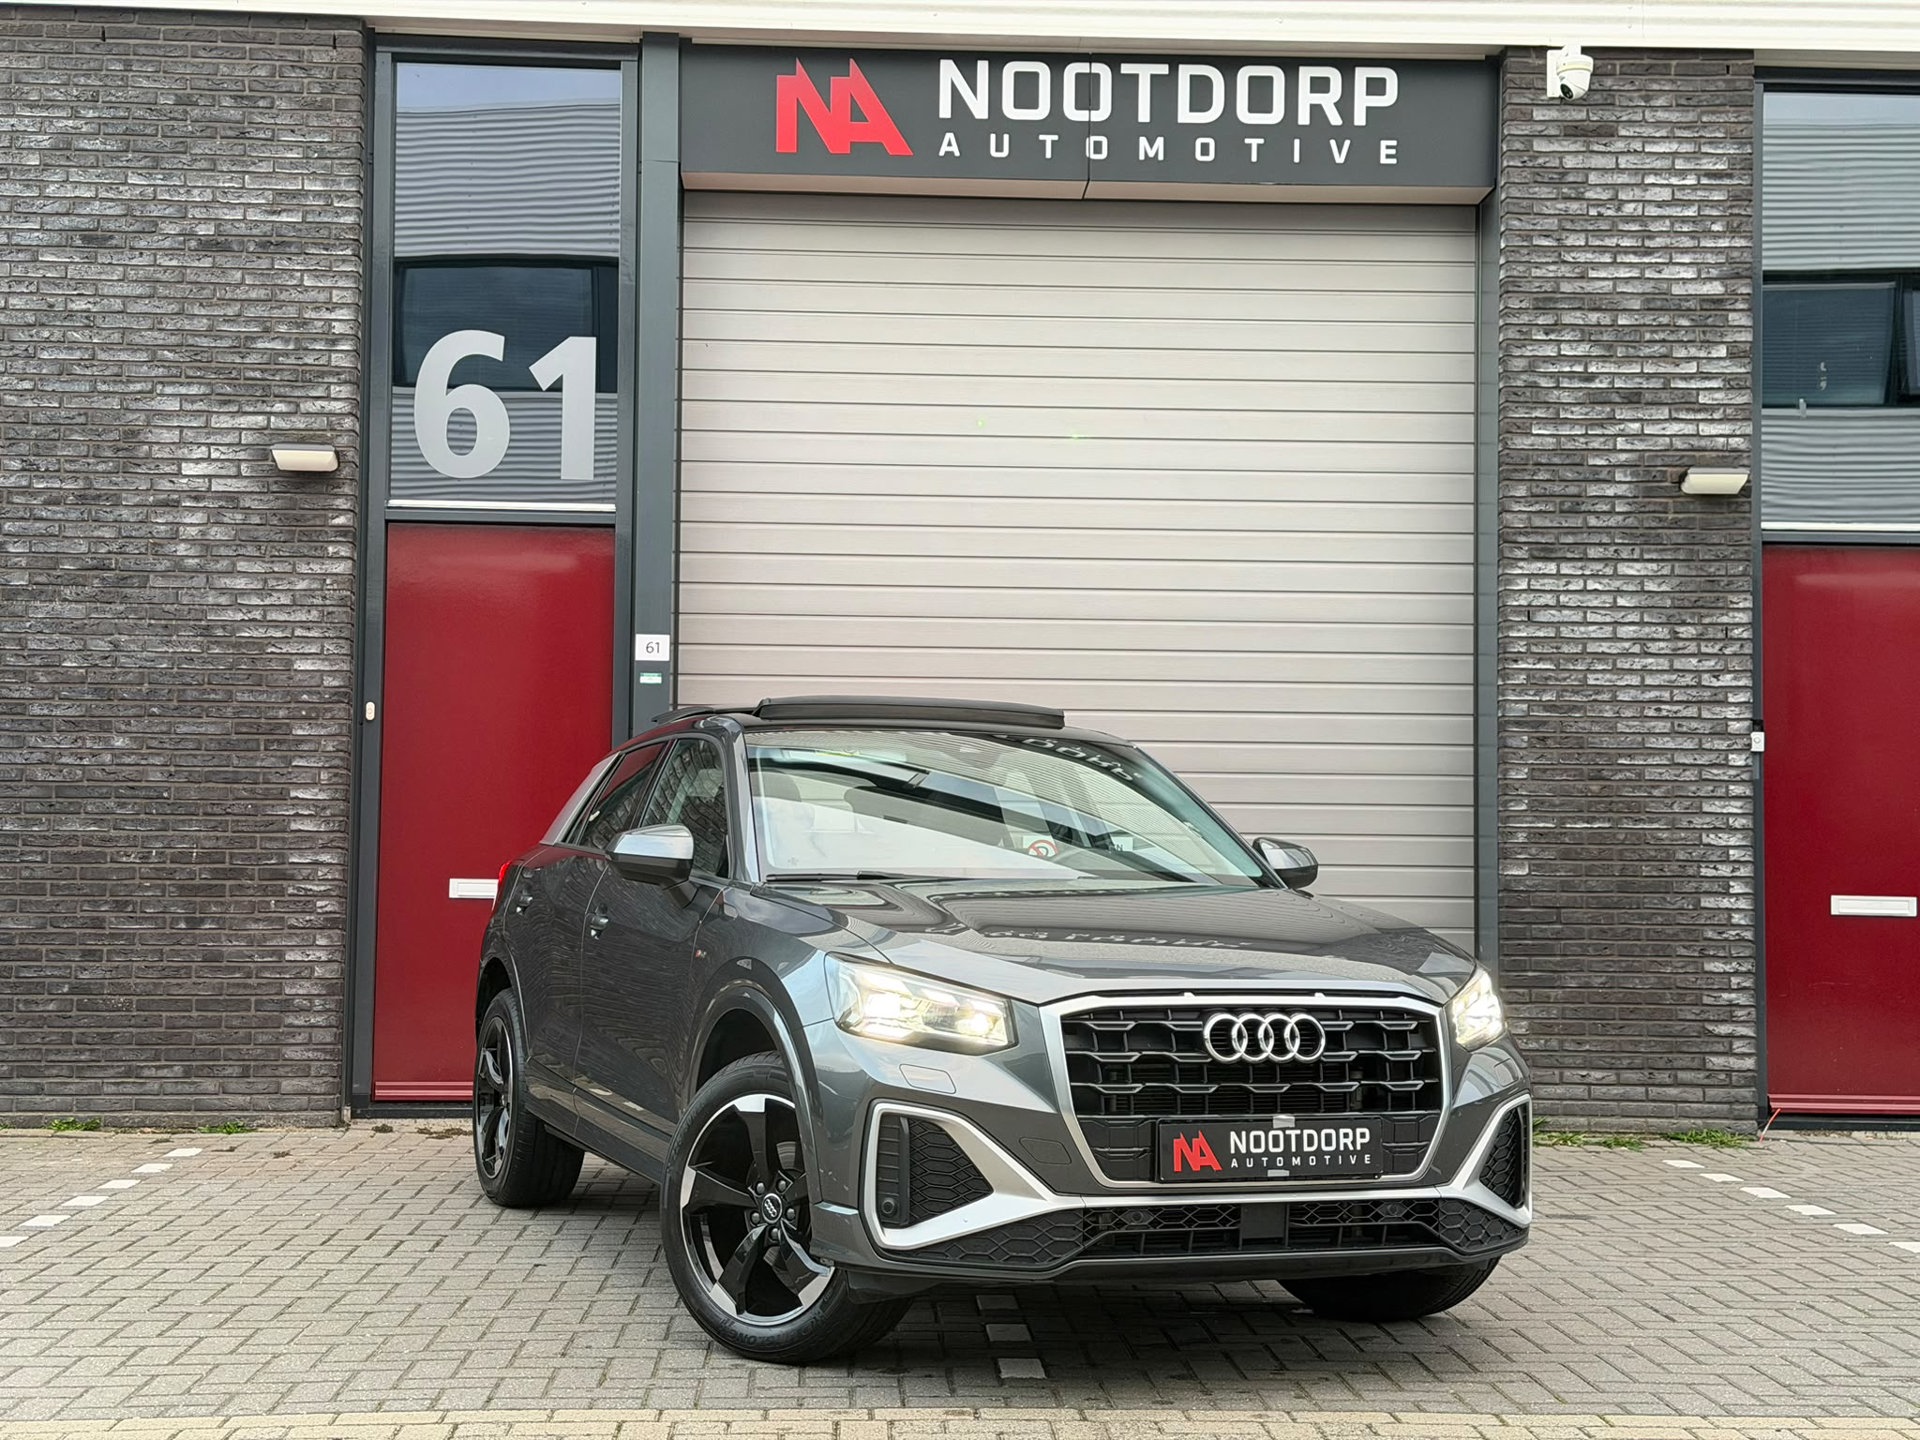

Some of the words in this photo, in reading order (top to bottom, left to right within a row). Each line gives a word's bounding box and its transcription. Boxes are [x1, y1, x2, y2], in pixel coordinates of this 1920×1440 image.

[938, 59, 1398, 126] NOOTDORP
[938, 132, 1398, 165] AUTOMOTIVE
[414, 329, 597, 480] 61
[645, 641, 660, 654] 61
[1230, 1128, 1371, 1154] NOOTDORP
[1230, 1154, 1372, 1169] AUTOMOTIVE
